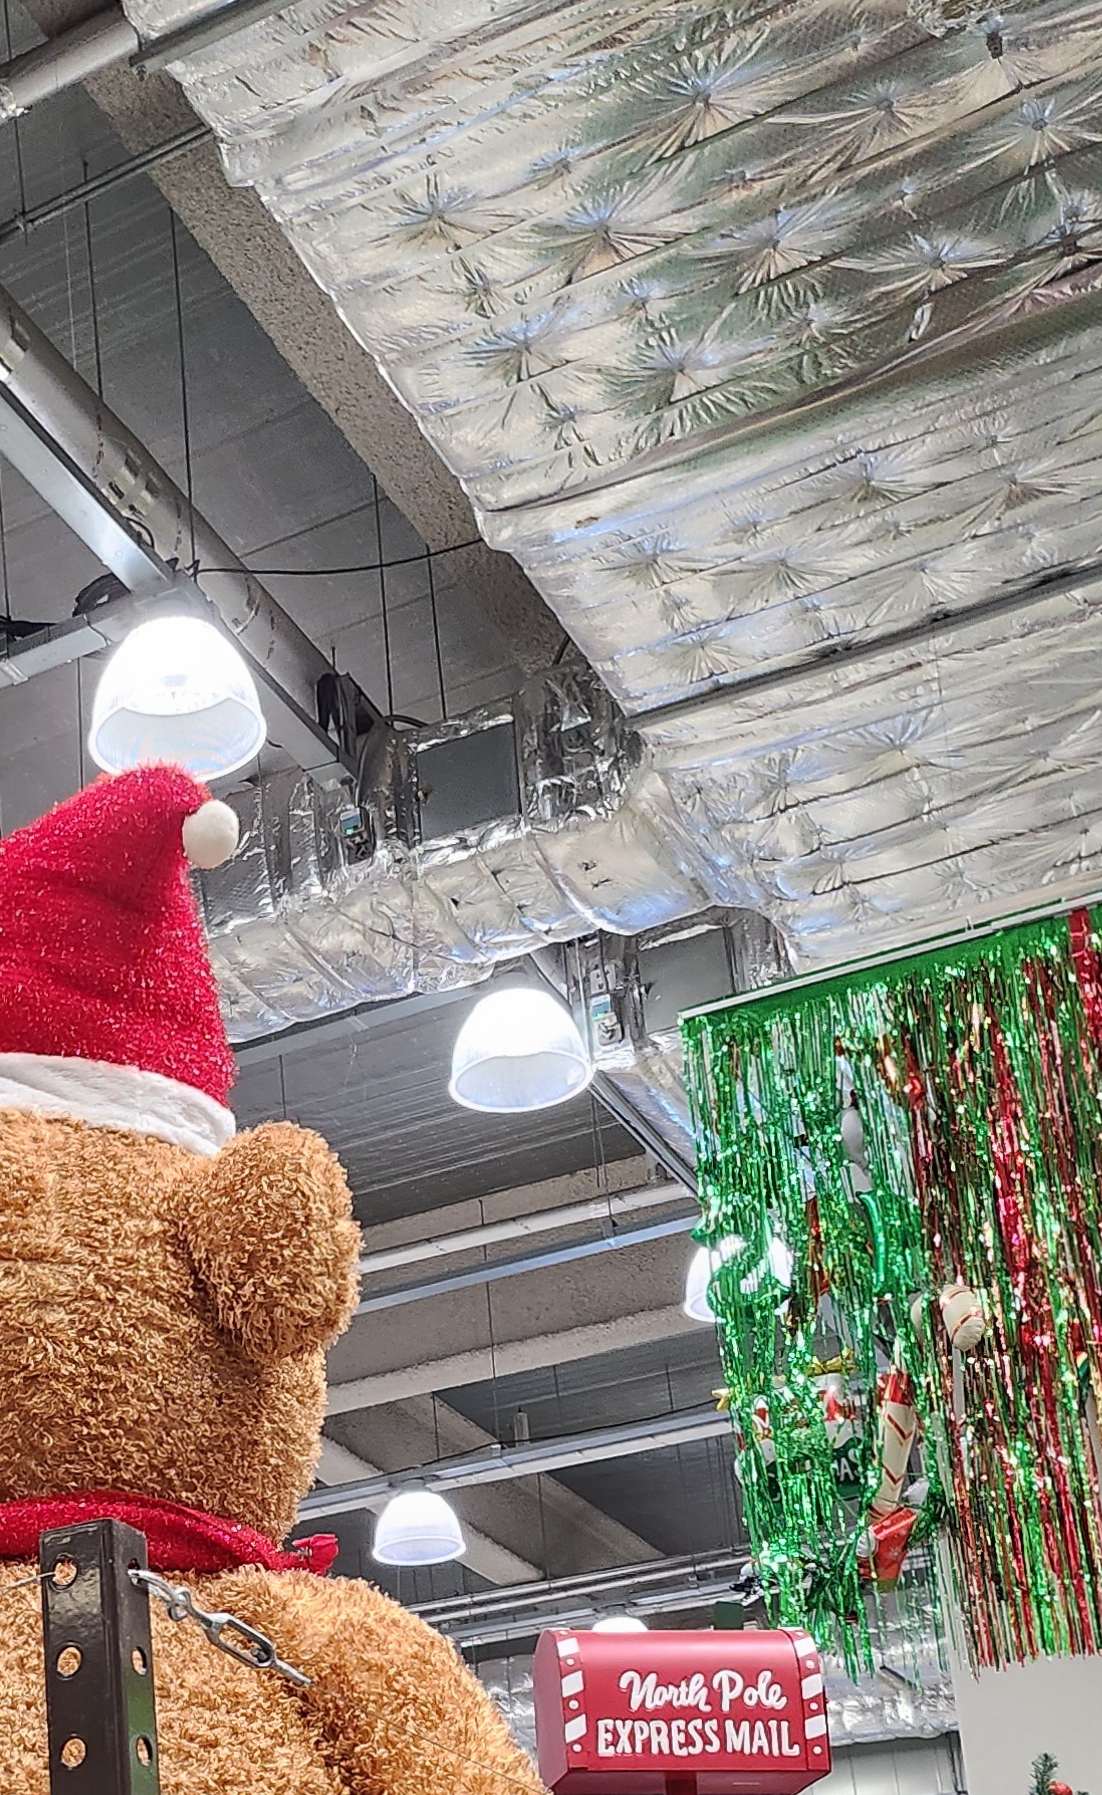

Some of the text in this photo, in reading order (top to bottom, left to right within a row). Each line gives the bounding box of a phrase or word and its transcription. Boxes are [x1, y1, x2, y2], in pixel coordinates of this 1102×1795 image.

[619, 1670, 788, 1714] North Pole
[596, 1718, 800, 1758] EXPRESS MAIL
